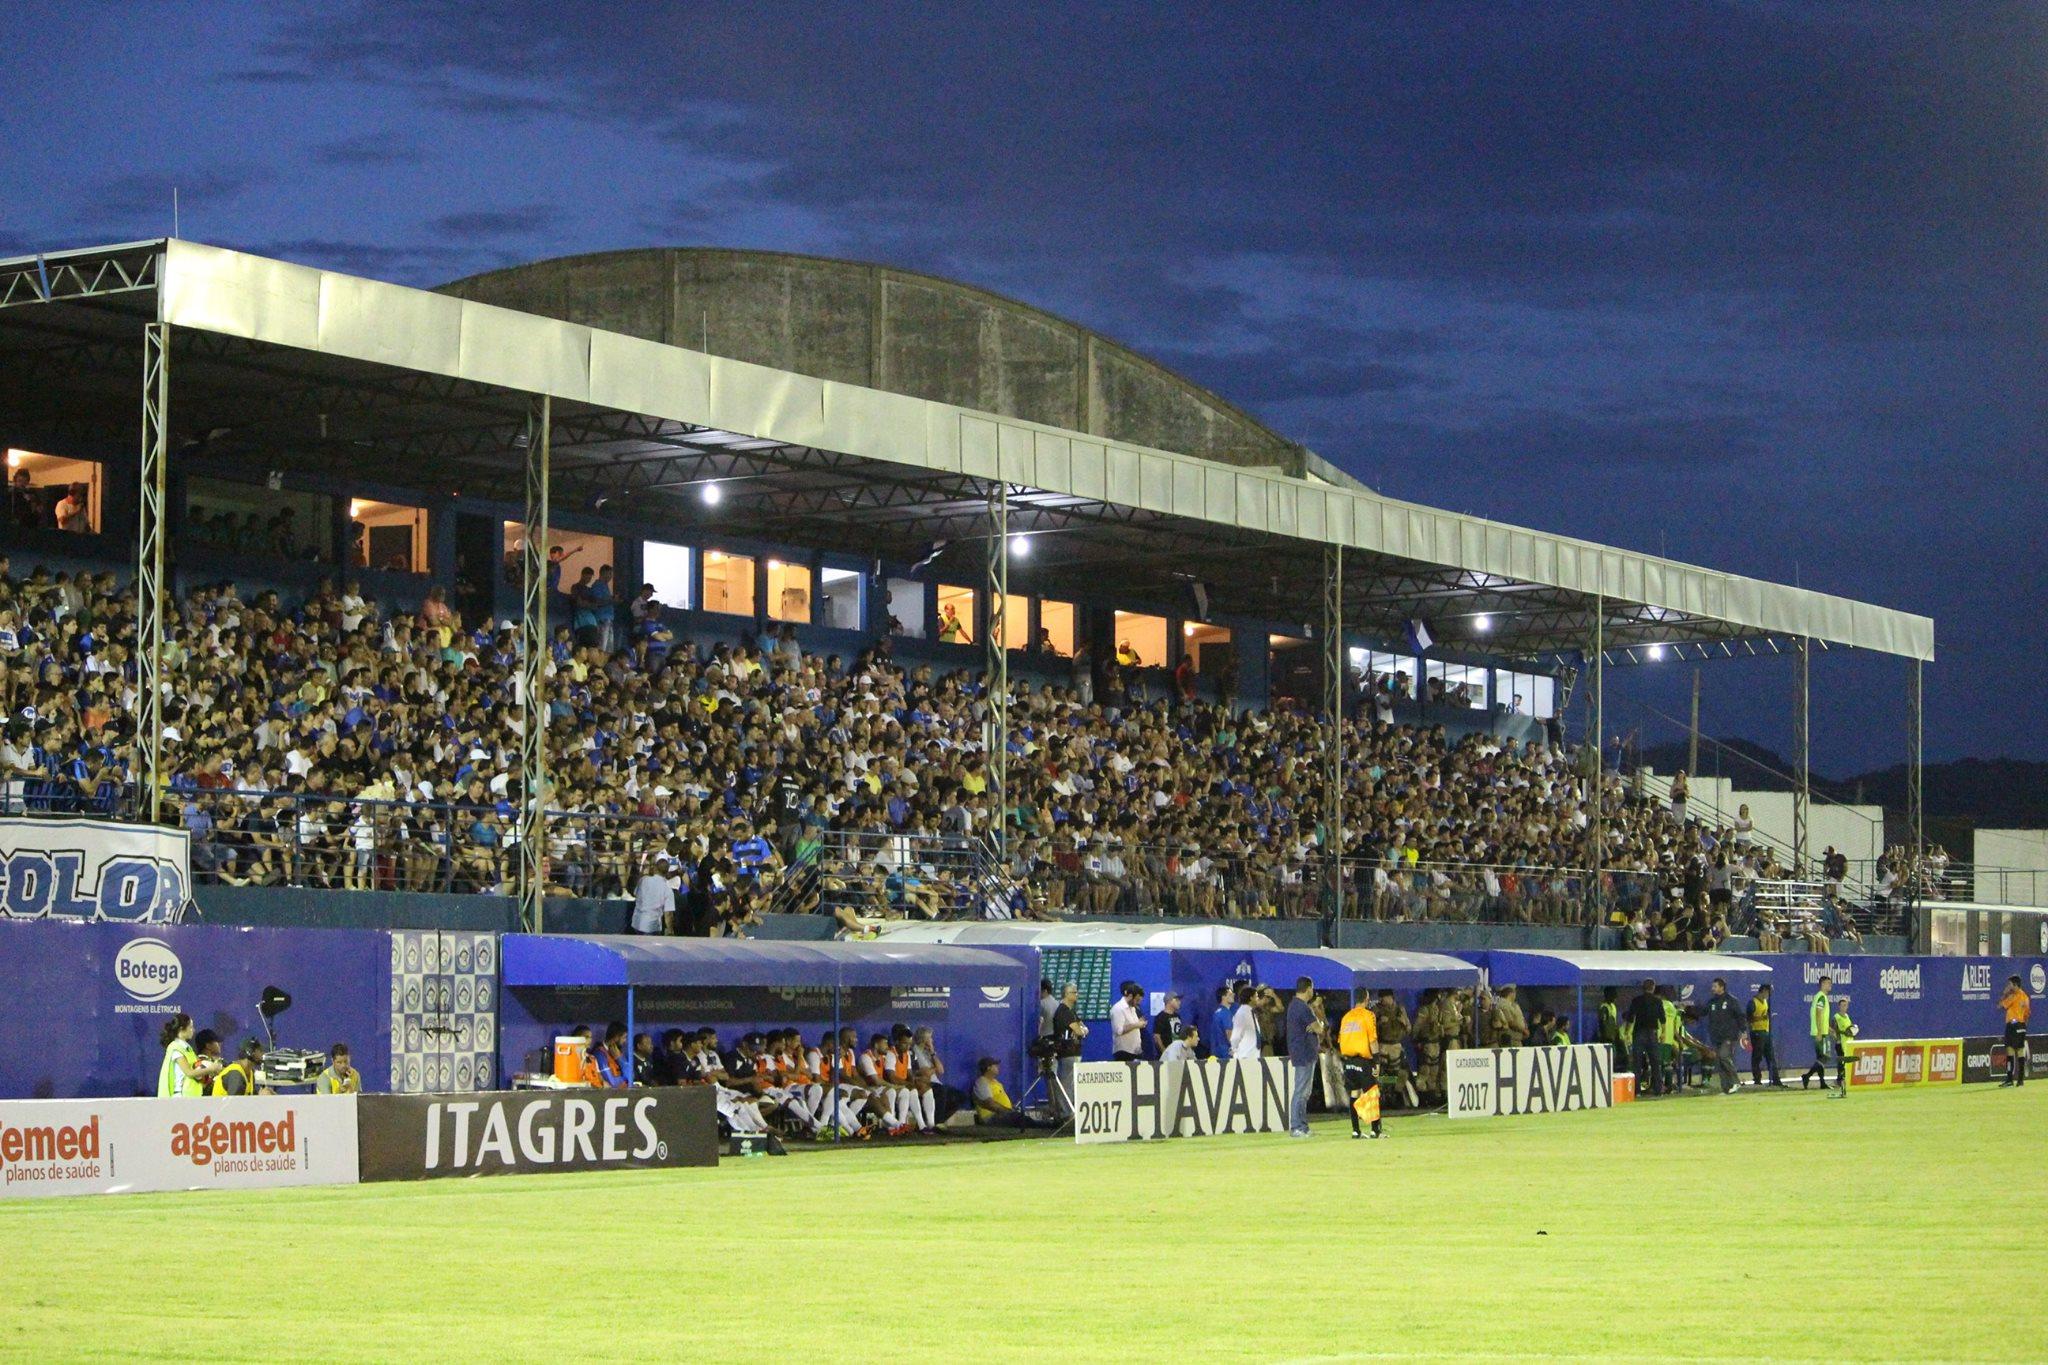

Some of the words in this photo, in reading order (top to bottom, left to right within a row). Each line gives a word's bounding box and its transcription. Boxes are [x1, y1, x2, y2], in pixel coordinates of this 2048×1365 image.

[120, 958, 178, 984] Botega
[1880, 964, 1921, 995] agemed
[114, 1005, 150, 1014] MONTAGENS
[150, 1003, 182, 1014] ELÉTRICAS
[1456, 1058, 1490, 1068] CATARINENSE
[1967, 1055, 1991, 1068] GRUPO
[1077, 1071, 1123, 1084] CATARINENSE
[1491, 1044, 1613, 1116] HAVAN
[1125, 1057, 1291, 1140] HAVAN
[1459, 1083, 1489, 1112] 2017
[1080, 1101, 1122, 1134] 2017
[0, 1115, 100, 1172] emed
[171, 1110, 295, 1166] agemed
[6, 1164, 46, 1186] planos
[48, 1163, 63, 1179] de
[66, 1161, 100, 1178] saúde
[214, 1158, 248, 1176] planos
[250, 1156, 264, 1171] de
[266, 1155, 296, 1171] saúde
